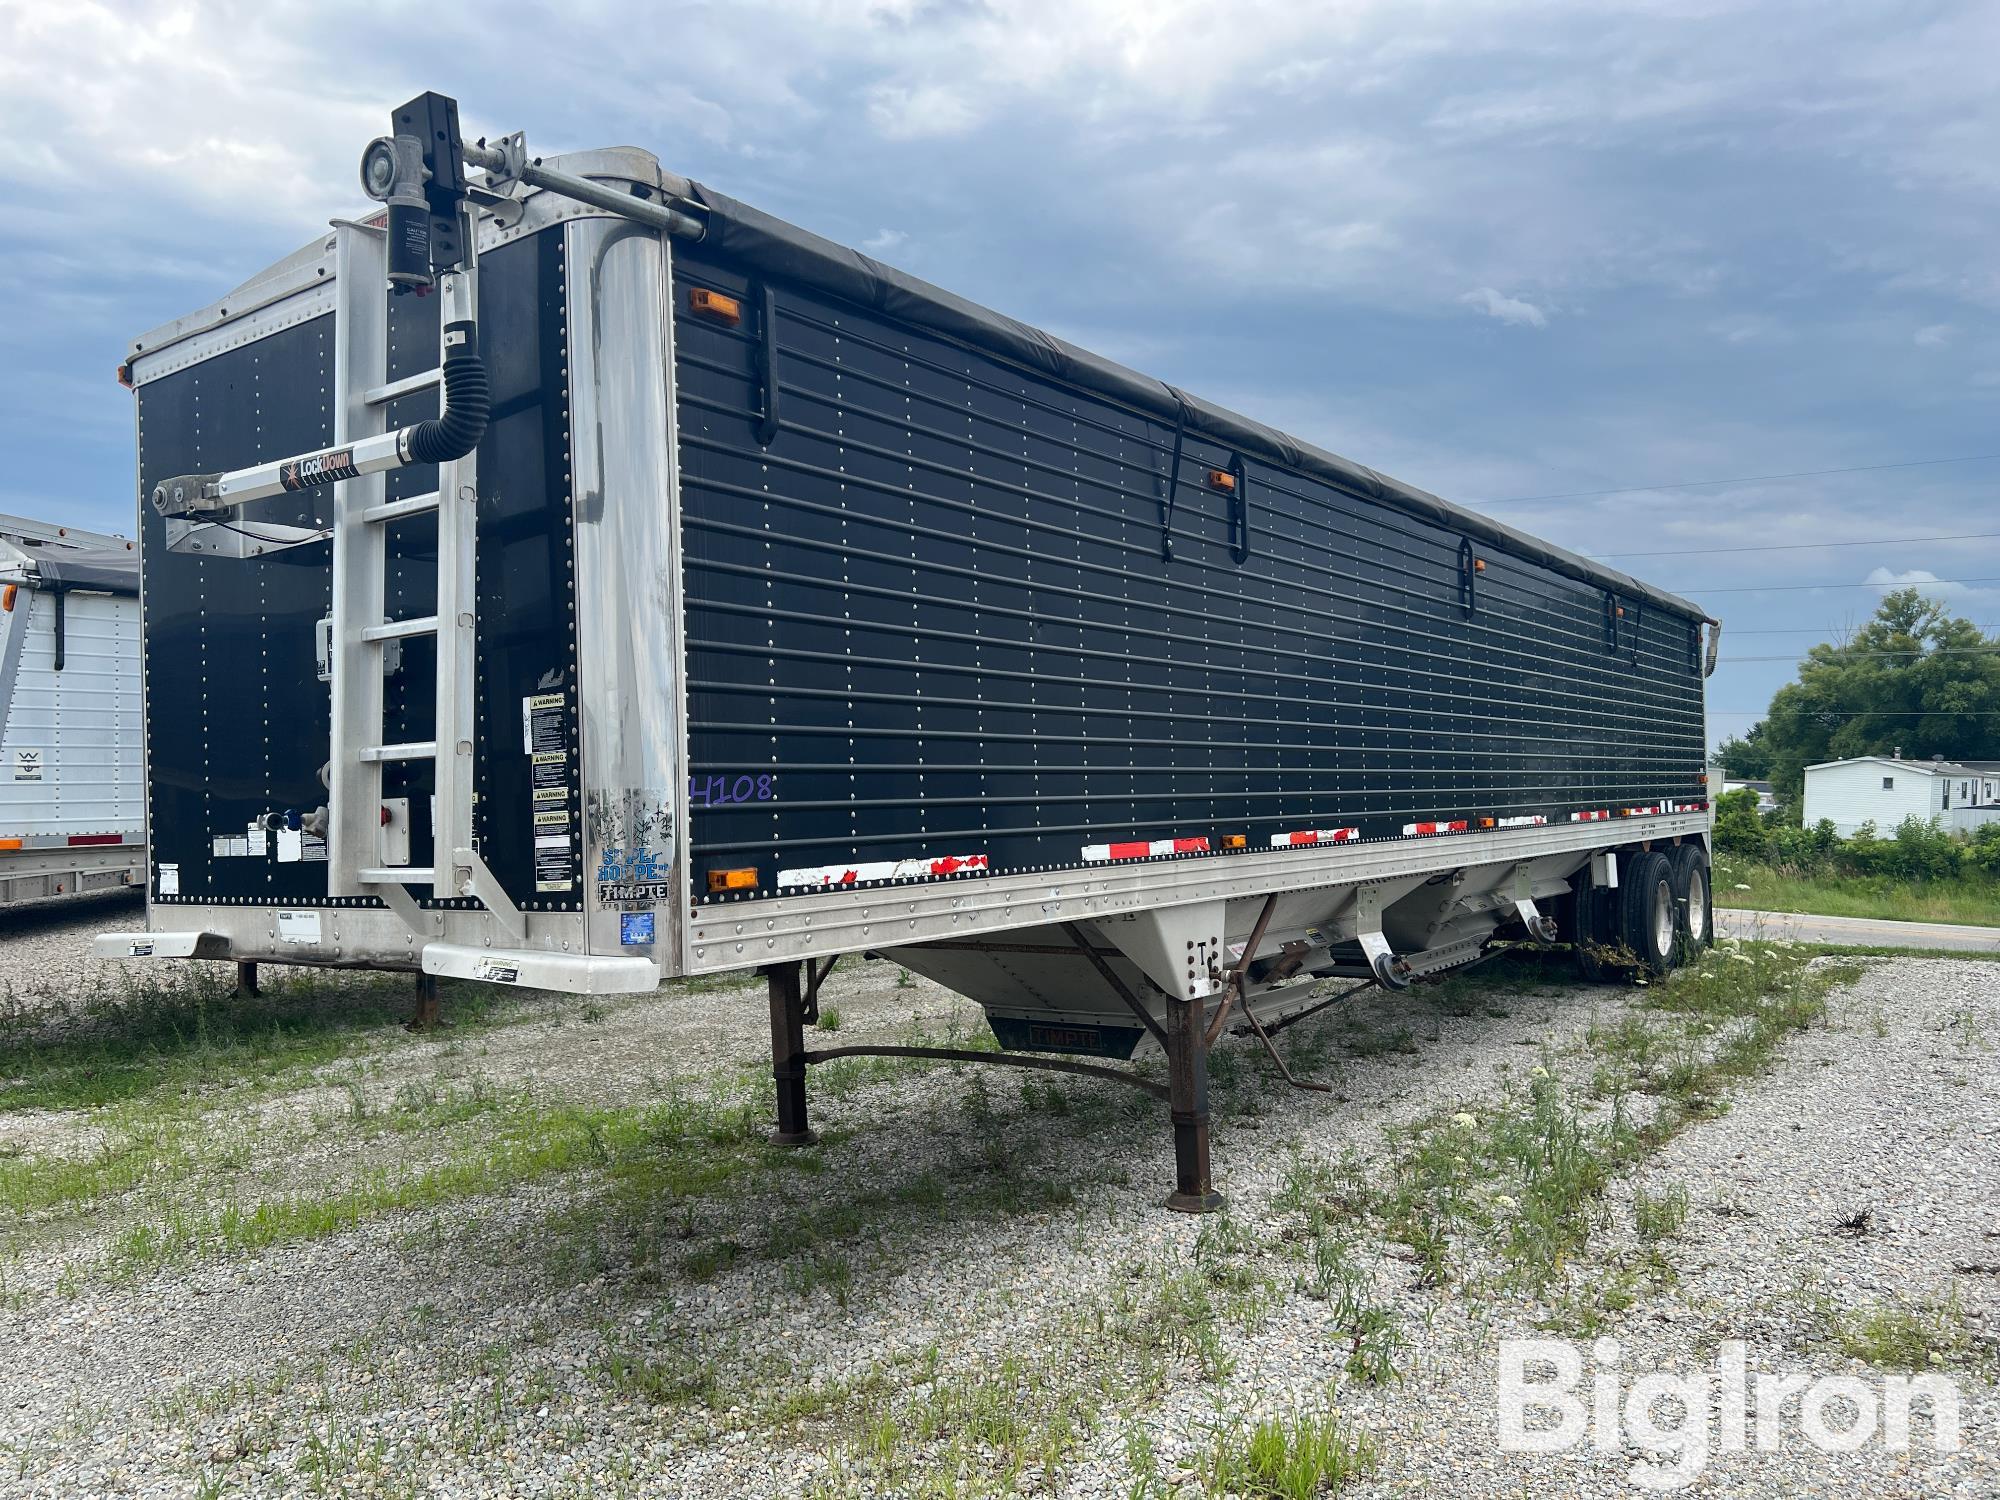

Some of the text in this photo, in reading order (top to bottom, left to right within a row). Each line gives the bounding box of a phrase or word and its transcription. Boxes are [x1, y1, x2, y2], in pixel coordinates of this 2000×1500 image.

[537, 697, 563, 706] WARNING
[540, 754, 564, 763] WARNING
[540, 790, 566, 799] WARNING
[689, 774, 772, 808] H108
[542, 814, 567, 823] WARNING
[602, 885, 667, 901] TIMPTE
